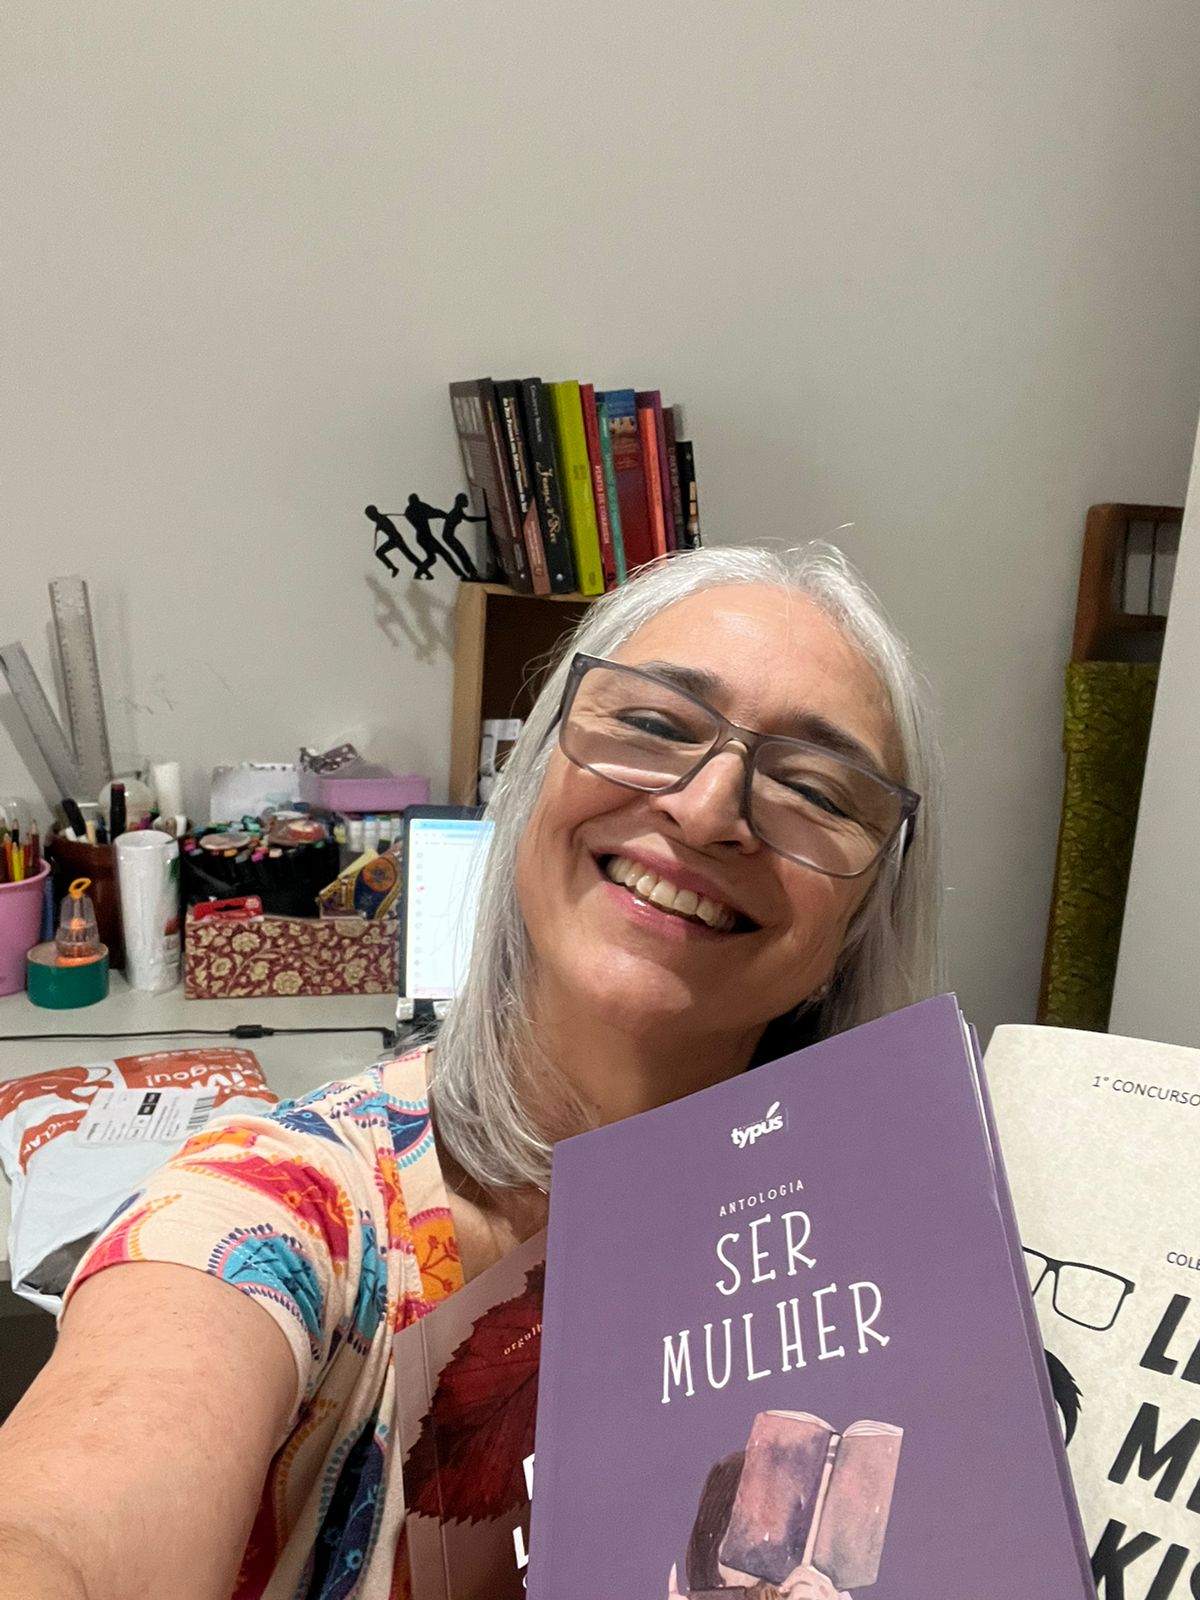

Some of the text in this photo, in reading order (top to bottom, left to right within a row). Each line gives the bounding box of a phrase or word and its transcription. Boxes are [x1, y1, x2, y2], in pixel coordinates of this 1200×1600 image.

[1112, 1079, 1200, 1107] CONCURSO
[719, 1179, 804, 1217] ANTOLOGIA
[715, 1210, 817, 1296] SER
[661, 1281, 890, 1404] MULHER
[1090, 1518, 1200, 1600] KI
